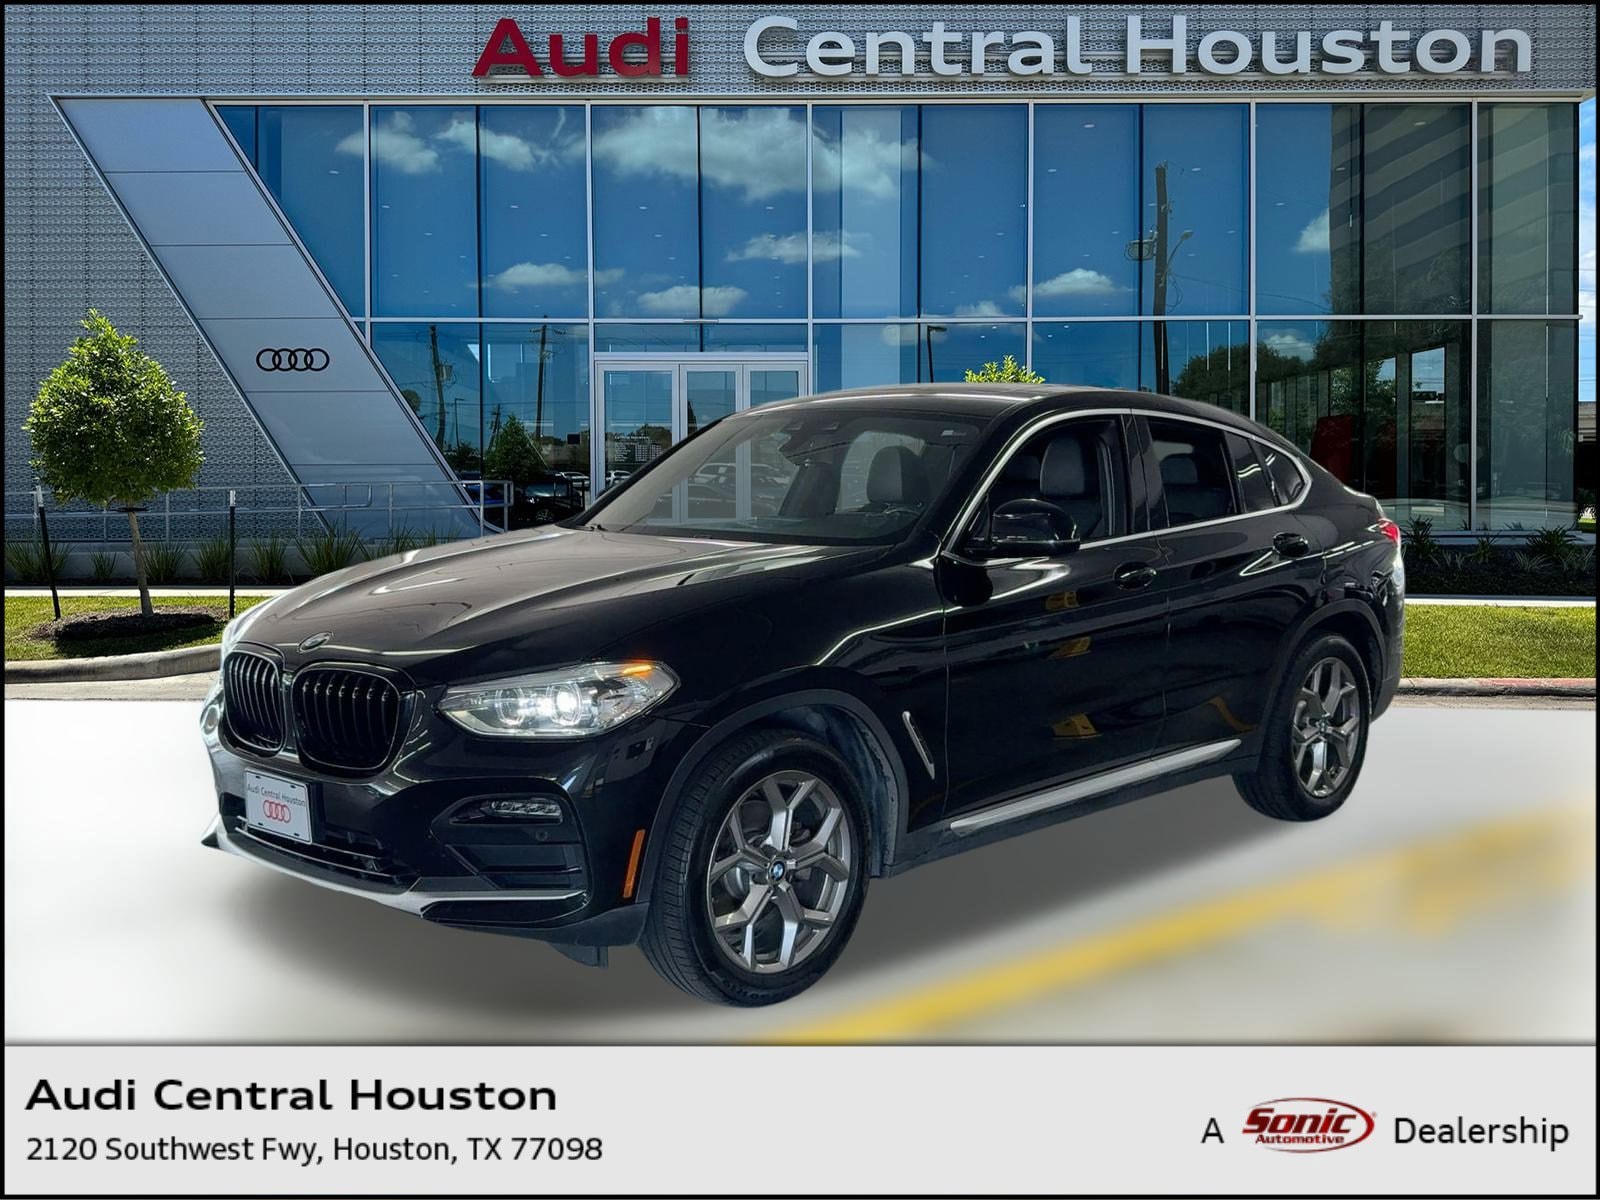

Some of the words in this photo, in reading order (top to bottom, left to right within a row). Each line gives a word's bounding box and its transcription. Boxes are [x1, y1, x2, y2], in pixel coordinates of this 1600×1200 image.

[471, 16, 689, 78] Audi
[743, 15, 1093, 77] Central
[1126, 15, 1532, 75] Houston
[261, 786, 281, 799] Central
[281, 792, 306, 807] Houston
